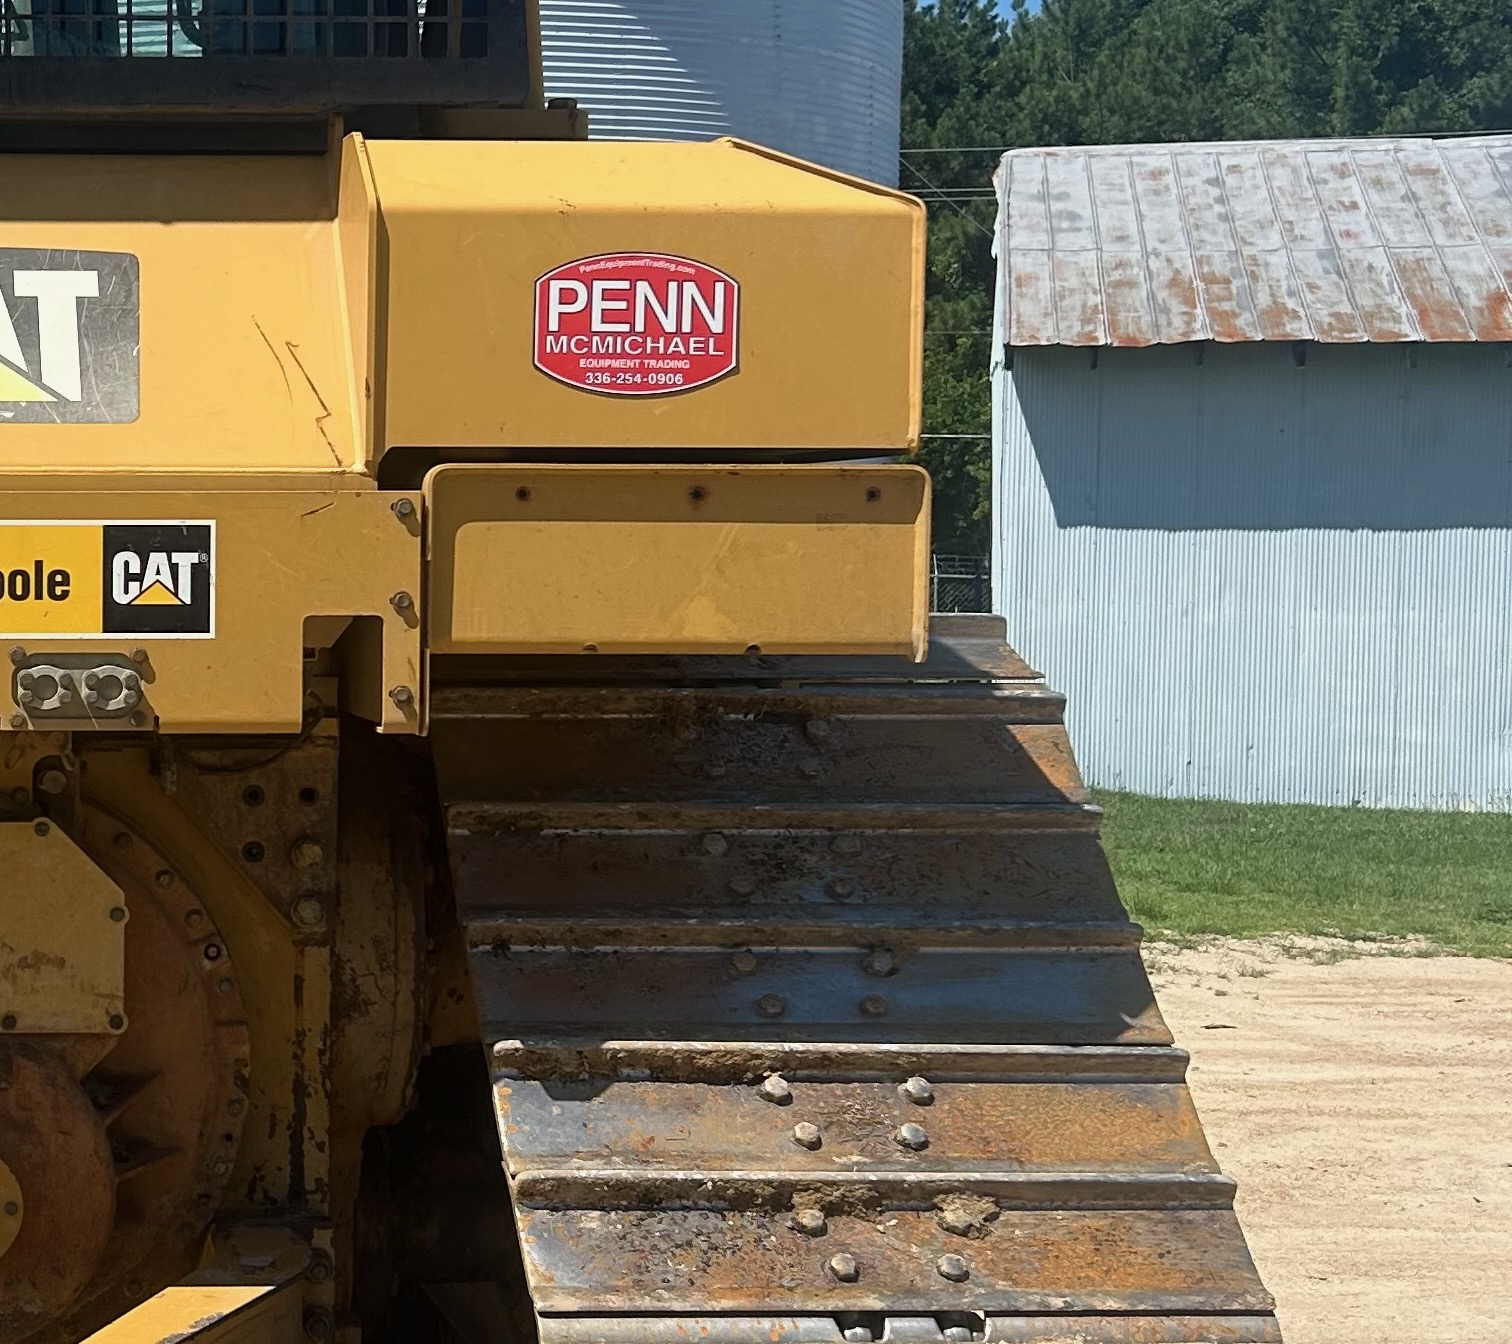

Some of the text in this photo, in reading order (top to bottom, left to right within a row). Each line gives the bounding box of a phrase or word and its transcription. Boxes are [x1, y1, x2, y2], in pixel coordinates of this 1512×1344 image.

[548, 279, 725, 333] PENN
[546, 335, 725, 355] MCMICHAEL
[579, 359, 690, 369] EQUIPMENT TRADING
[584, 372, 684, 385] 336-254-0906
